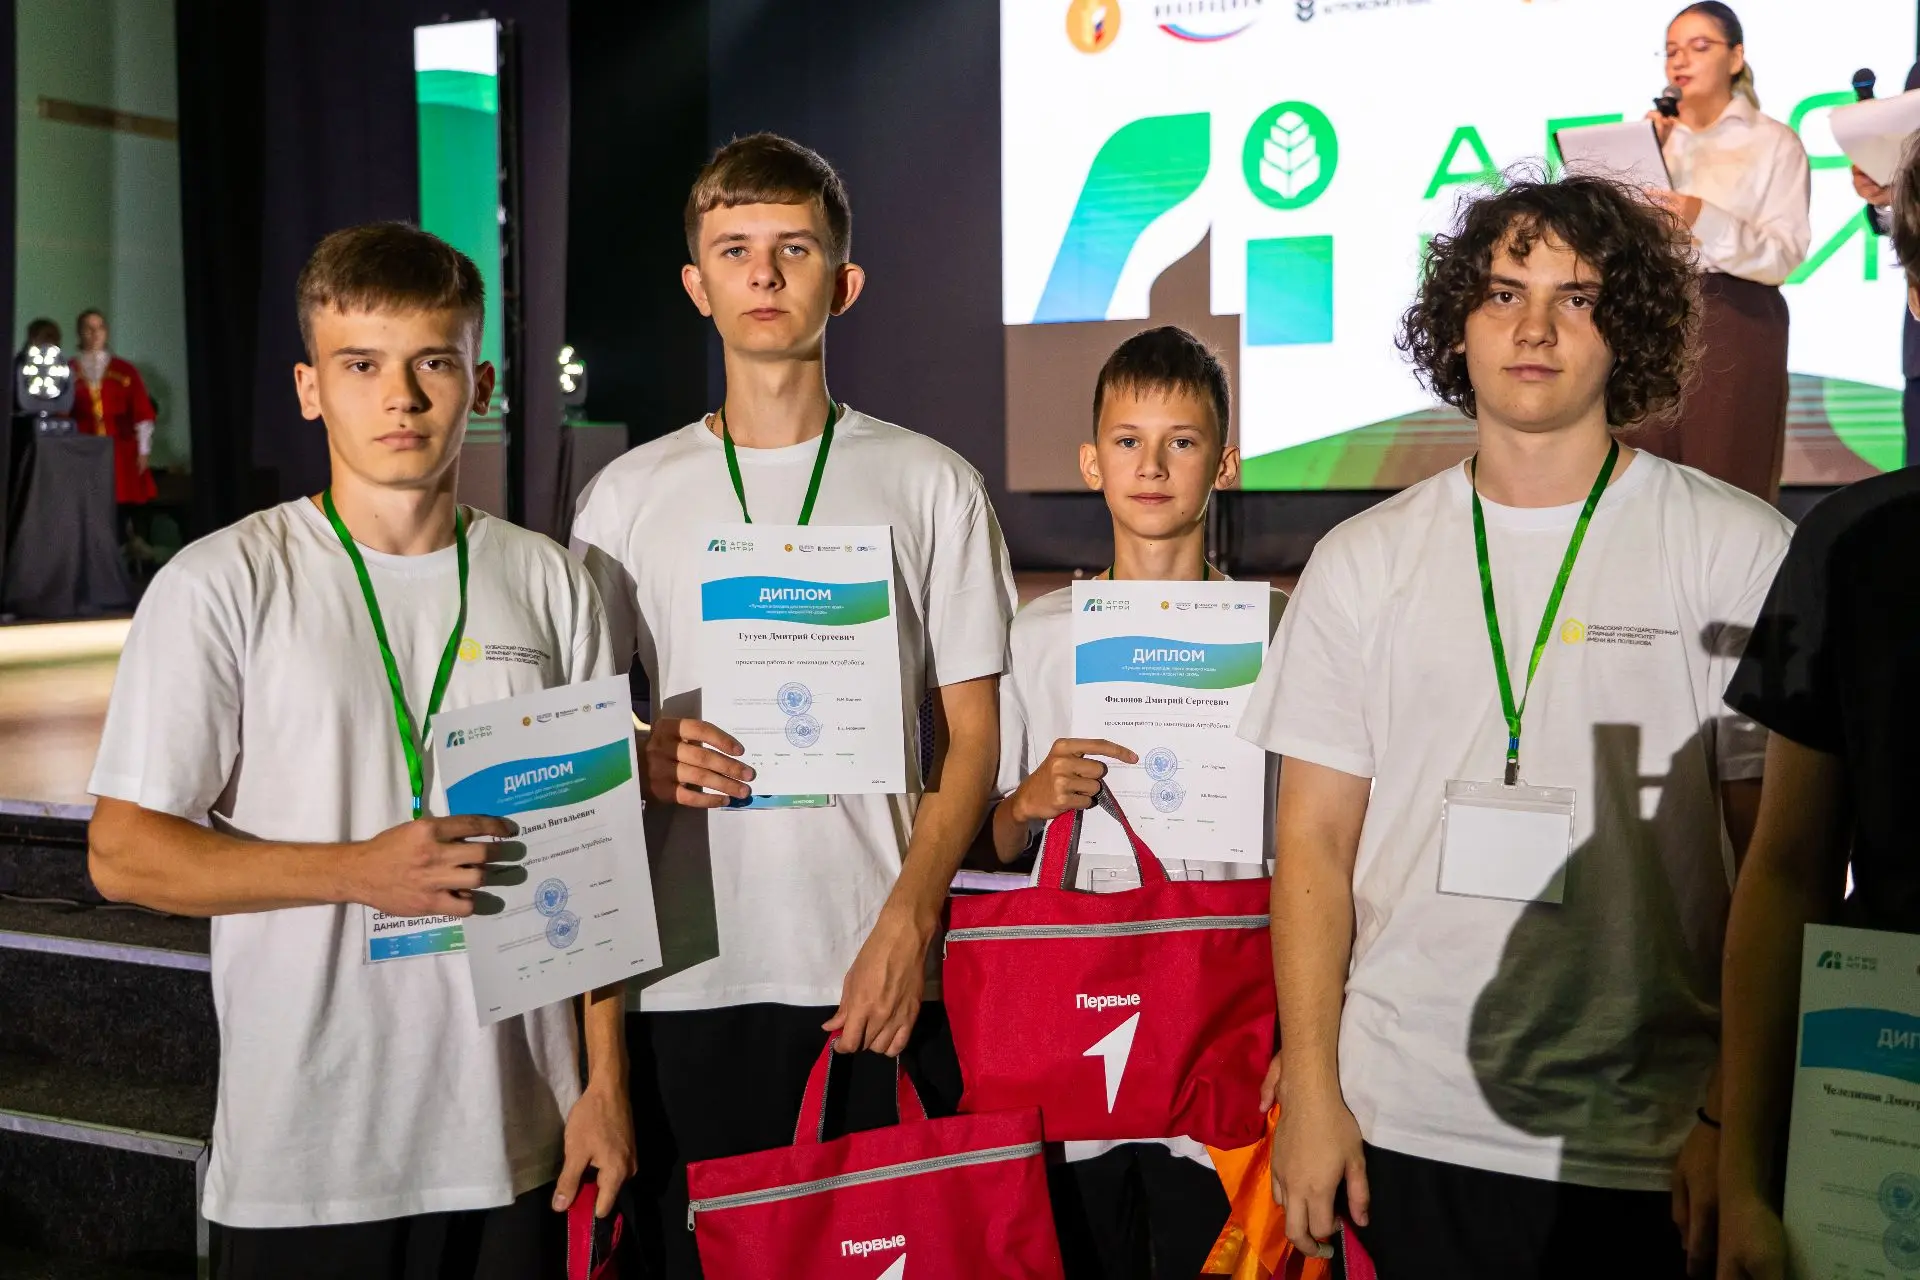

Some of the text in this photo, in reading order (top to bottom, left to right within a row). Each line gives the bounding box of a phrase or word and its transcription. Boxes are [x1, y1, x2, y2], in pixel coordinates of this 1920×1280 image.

[759, 587, 832, 603] ДИПЛОМ
[768, 632, 808, 641] Дмитрий
[810, 633, 856, 642] Сергеевич
[1616, 632, 1657, 640] УНИВЕРСИТЕТ
[1623, 626, 1679, 636] ГОСУДАРСТВЕННЫЙ
[1132, 648, 1206, 664] ДИПЛОМ
[1144, 695, 1184, 706] Дмитрий
[1185, 697, 1230, 707] Сергеевич
[504, 760, 574, 795] ДИПЛОМ
[521, 823, 547, 836] Данил
[548, 808, 597, 829] Витальевич
[373, 921, 406, 932] ДАНИЛ
[1076, 993, 1141, 1012] Первые
[1877, 1028, 1920, 1050] ДИП
[841, 1234, 906, 1257] Первые
